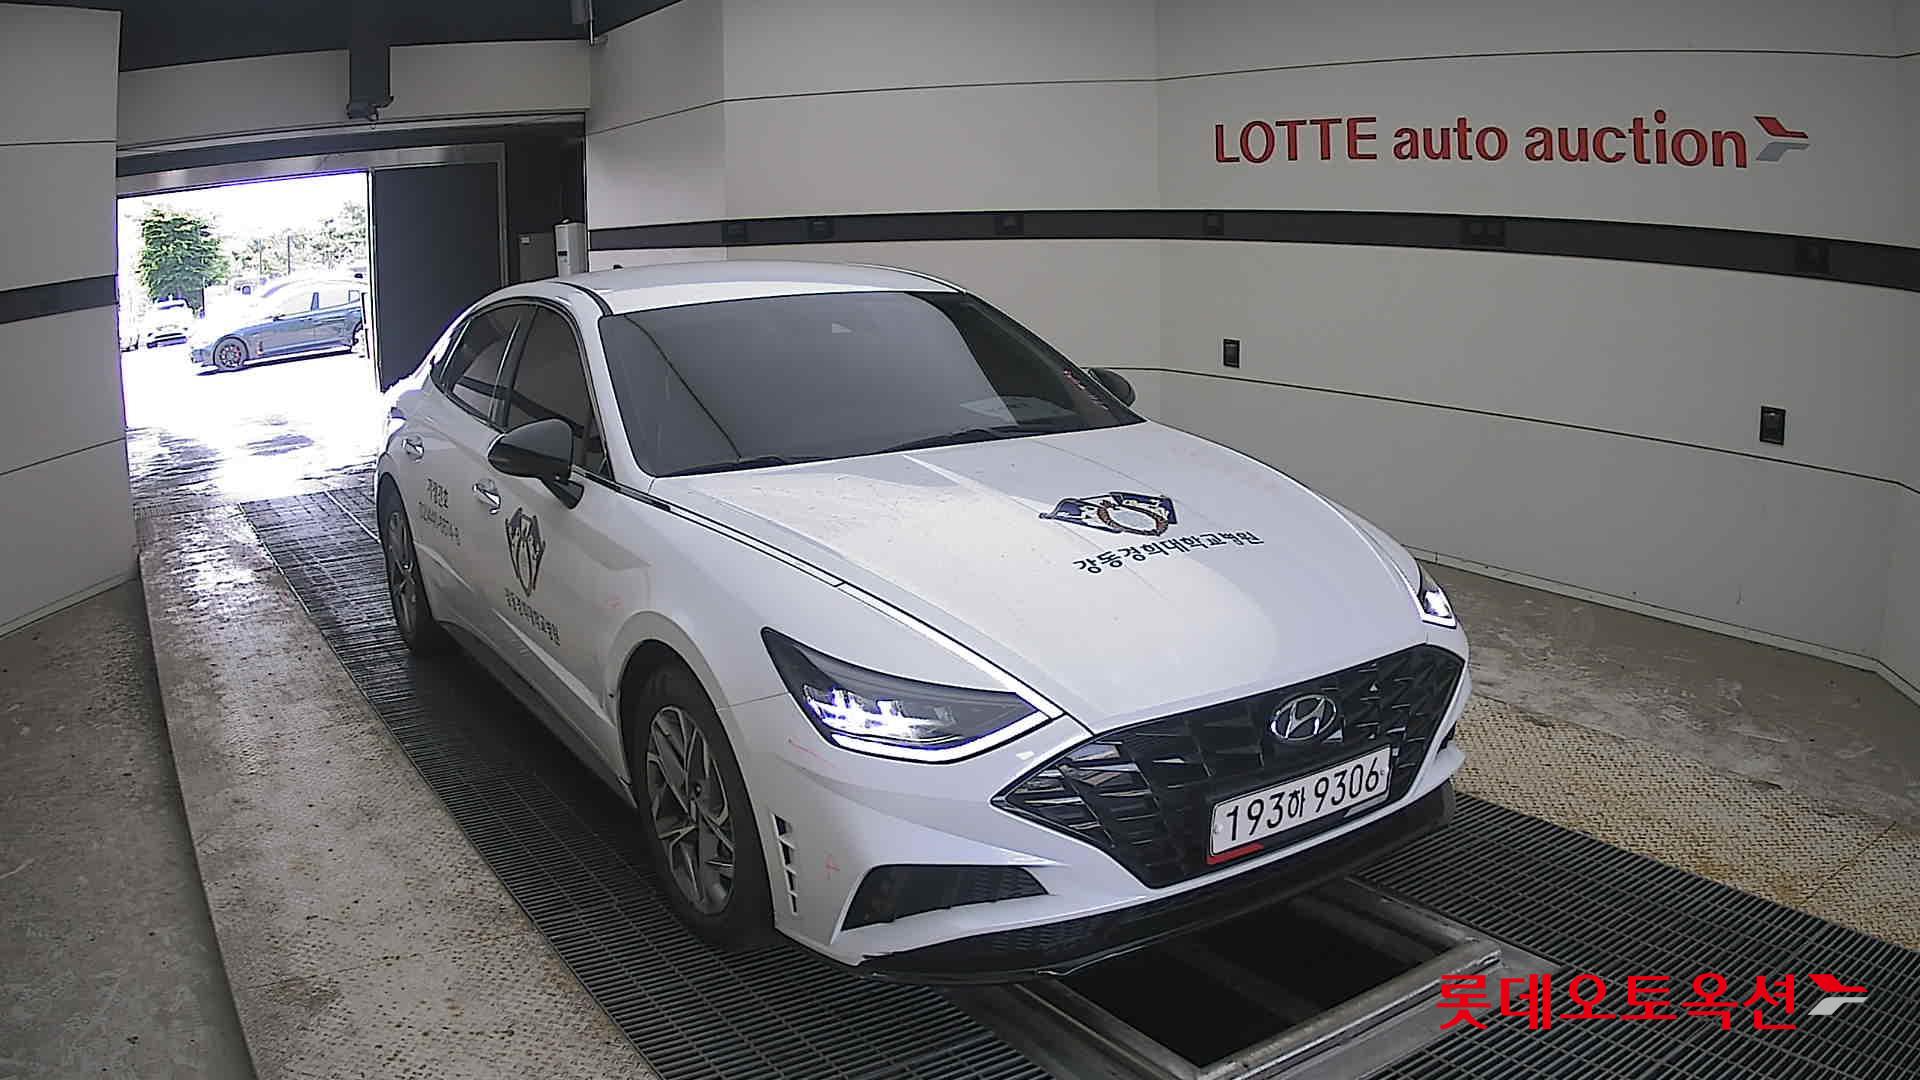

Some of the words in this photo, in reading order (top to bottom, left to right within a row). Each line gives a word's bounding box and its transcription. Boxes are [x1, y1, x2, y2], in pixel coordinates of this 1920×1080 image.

[1215, 116, 1378, 164] LOTTE
[1393, 117, 1509, 161] auto
[1525, 109, 1748, 169] auction
[1072, 530, 1265, 575] 강동경희대학교병원
[1226, 786, 1306, 842] 193하
[1313, 756, 1380, 814] 9306
